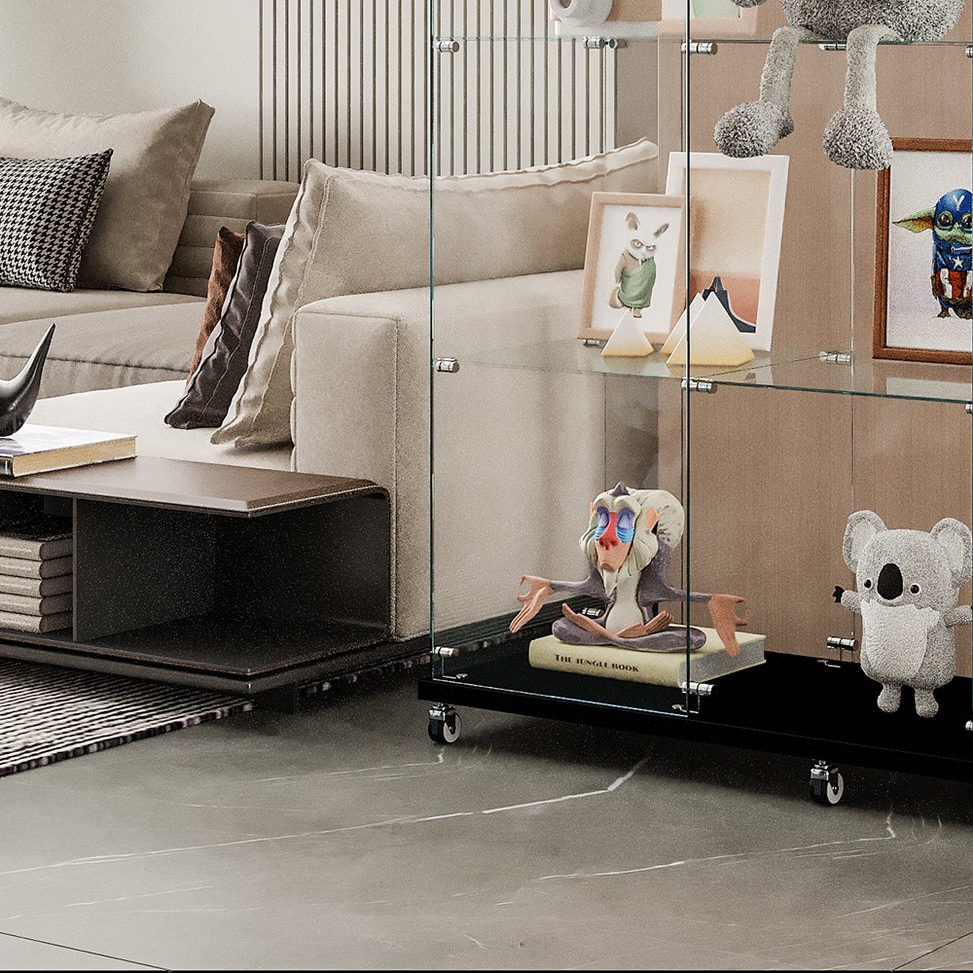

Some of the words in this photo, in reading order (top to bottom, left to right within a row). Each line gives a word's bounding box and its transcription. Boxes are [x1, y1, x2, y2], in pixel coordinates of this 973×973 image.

[952, 194, 965, 211] Y
[555, 654, 572, 664] THE
[576, 658, 609, 668] JUNGLE
[611, 663, 640, 673] BOOK
